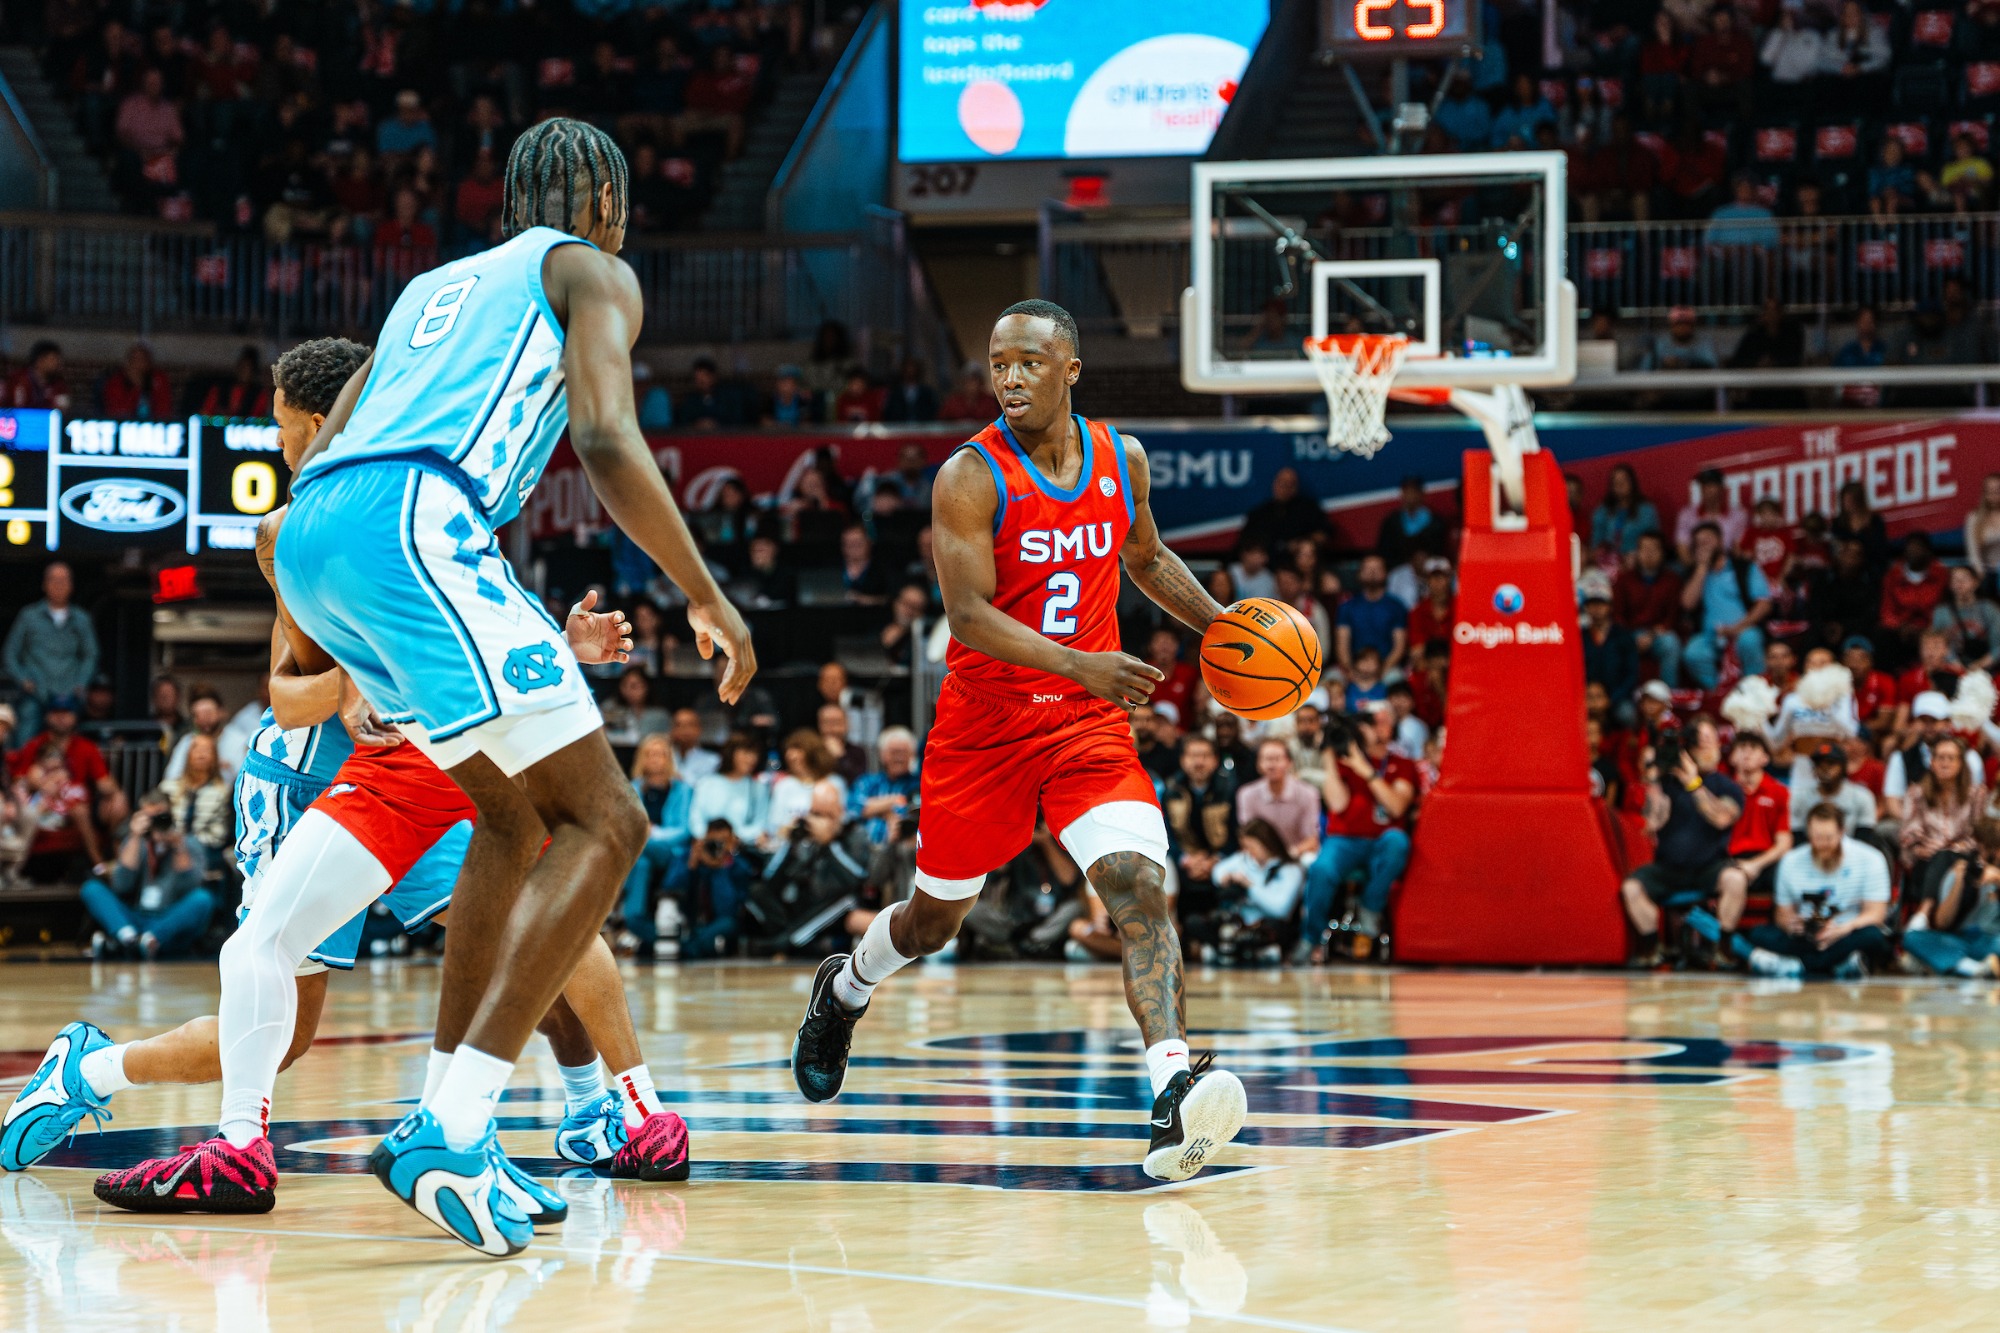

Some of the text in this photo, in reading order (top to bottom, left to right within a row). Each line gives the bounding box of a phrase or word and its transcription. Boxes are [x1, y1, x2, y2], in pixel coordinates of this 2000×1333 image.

[982, 33, 1022, 51] the
[923, 61, 1074, 84] leaderboard
[909, 166, 978, 196] 207
[408, 274, 480, 350] 8
[66, 420, 185, 457] 1ST HALF
[1803, 427, 1841, 457] THE
[231, 461, 277, 514] 0
[1149, 449, 1253, 488] SMU
[1690, 433, 1957, 525] TAMPEDE
[83, 484, 164, 522] Ford
[1019, 522, 1112, 563] SMU
[1040, 571, 1081, 635] 2
[1453, 621, 1564, 649] Origin Bank
